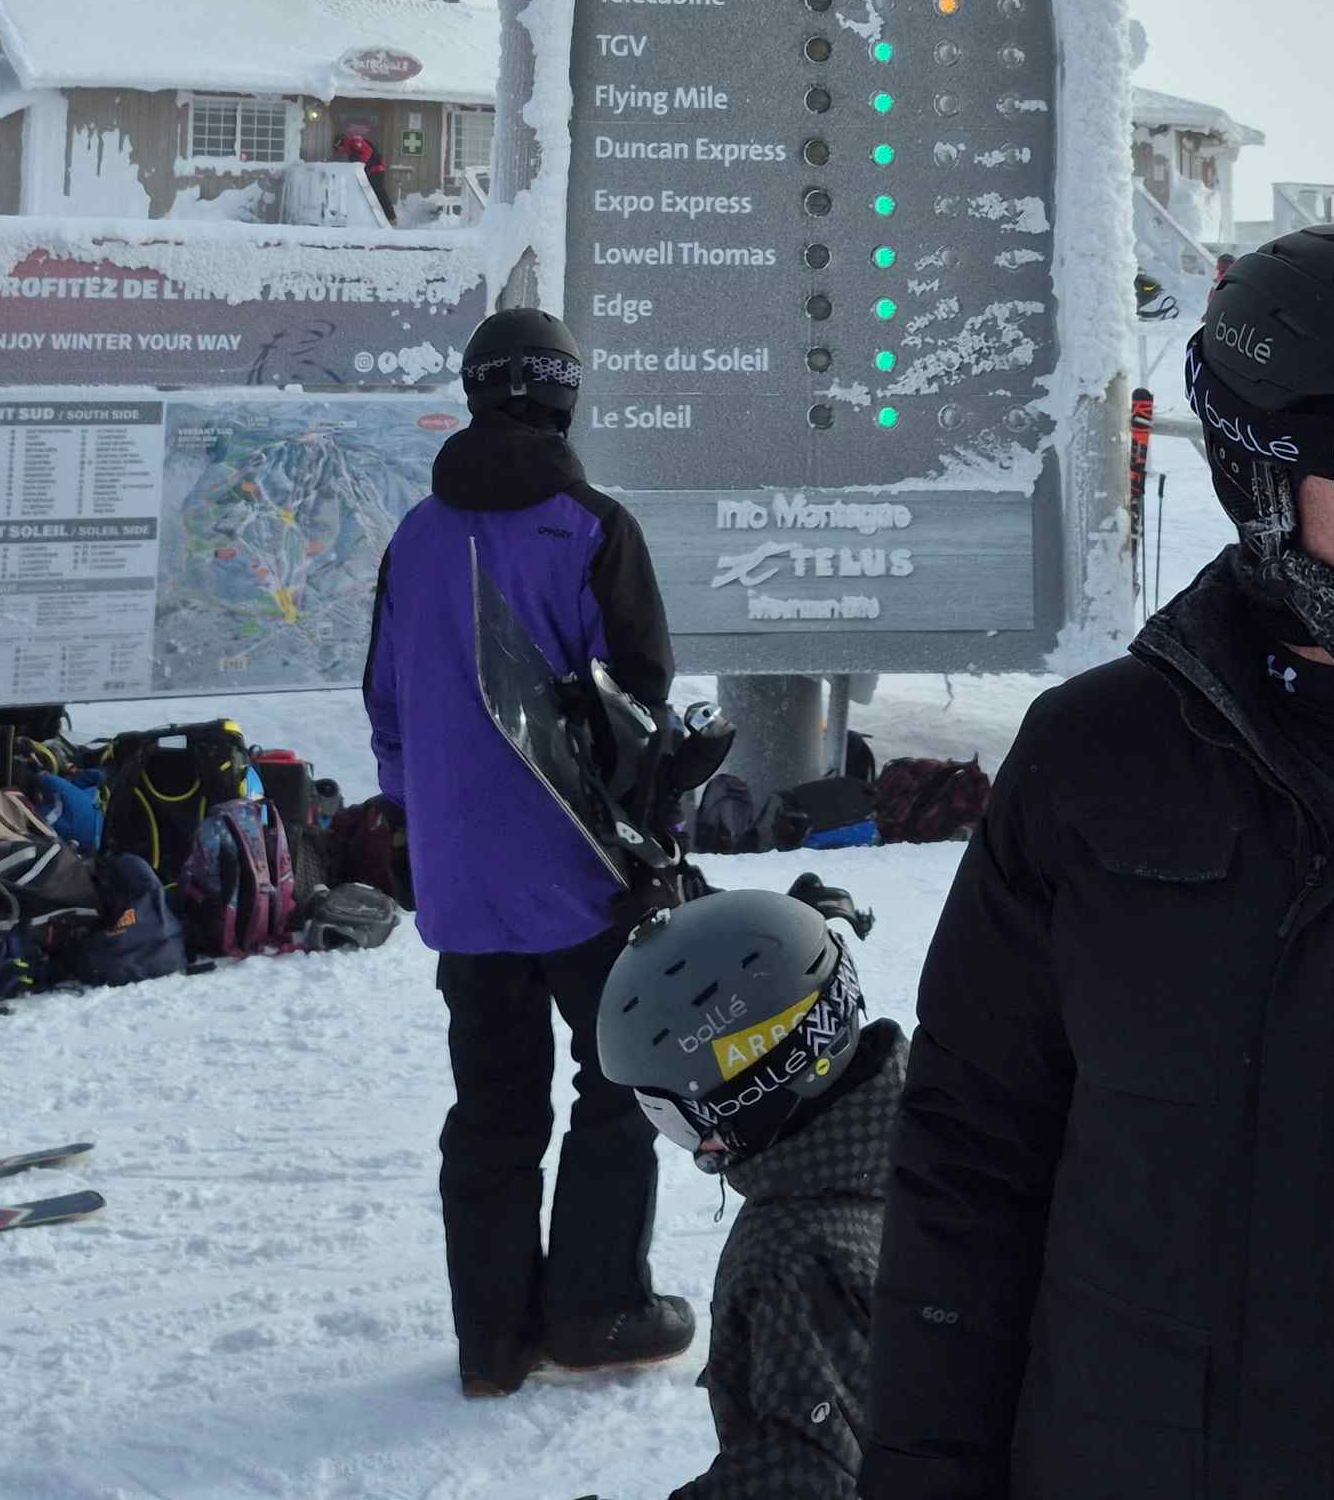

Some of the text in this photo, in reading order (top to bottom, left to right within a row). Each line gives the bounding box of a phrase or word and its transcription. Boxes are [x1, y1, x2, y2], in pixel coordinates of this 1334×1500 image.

[595, 34, 648, 57] TGV
[594, 83, 729, 116] Flying Mile
[594, 135, 787, 167] Duncan Express
[593, 189, 753, 220] Expo Express
[593, 240, 777, 267] Lowell Thomas
[123, 278, 158, 299] DE
[592, 292, 654, 324] Edge
[50, 332, 133, 351] WINTER
[137, 333, 193, 351] YOUR
[197, 334, 242, 351] WAY
[1215, 311, 1275, 365] bollé
[592, 347, 769, 373] Porte du Soleil
[18, 406, 55, 420] SUD
[67, 408, 110, 420] SOUTH
[112, 408, 140, 420] SIDE
[592, 404, 692, 429] Le Soleil
[1205, 389, 1300, 462] bollé
[8, 521, 69, 539] SOLEIL
[78, 524, 120, 537] SOLEIL
[123, 523, 150, 535] SIDE
[788, 547, 915, 578] TELUS
[677, 993, 749, 1054] bollé
[707, 1046, 809, 1117] bollé
